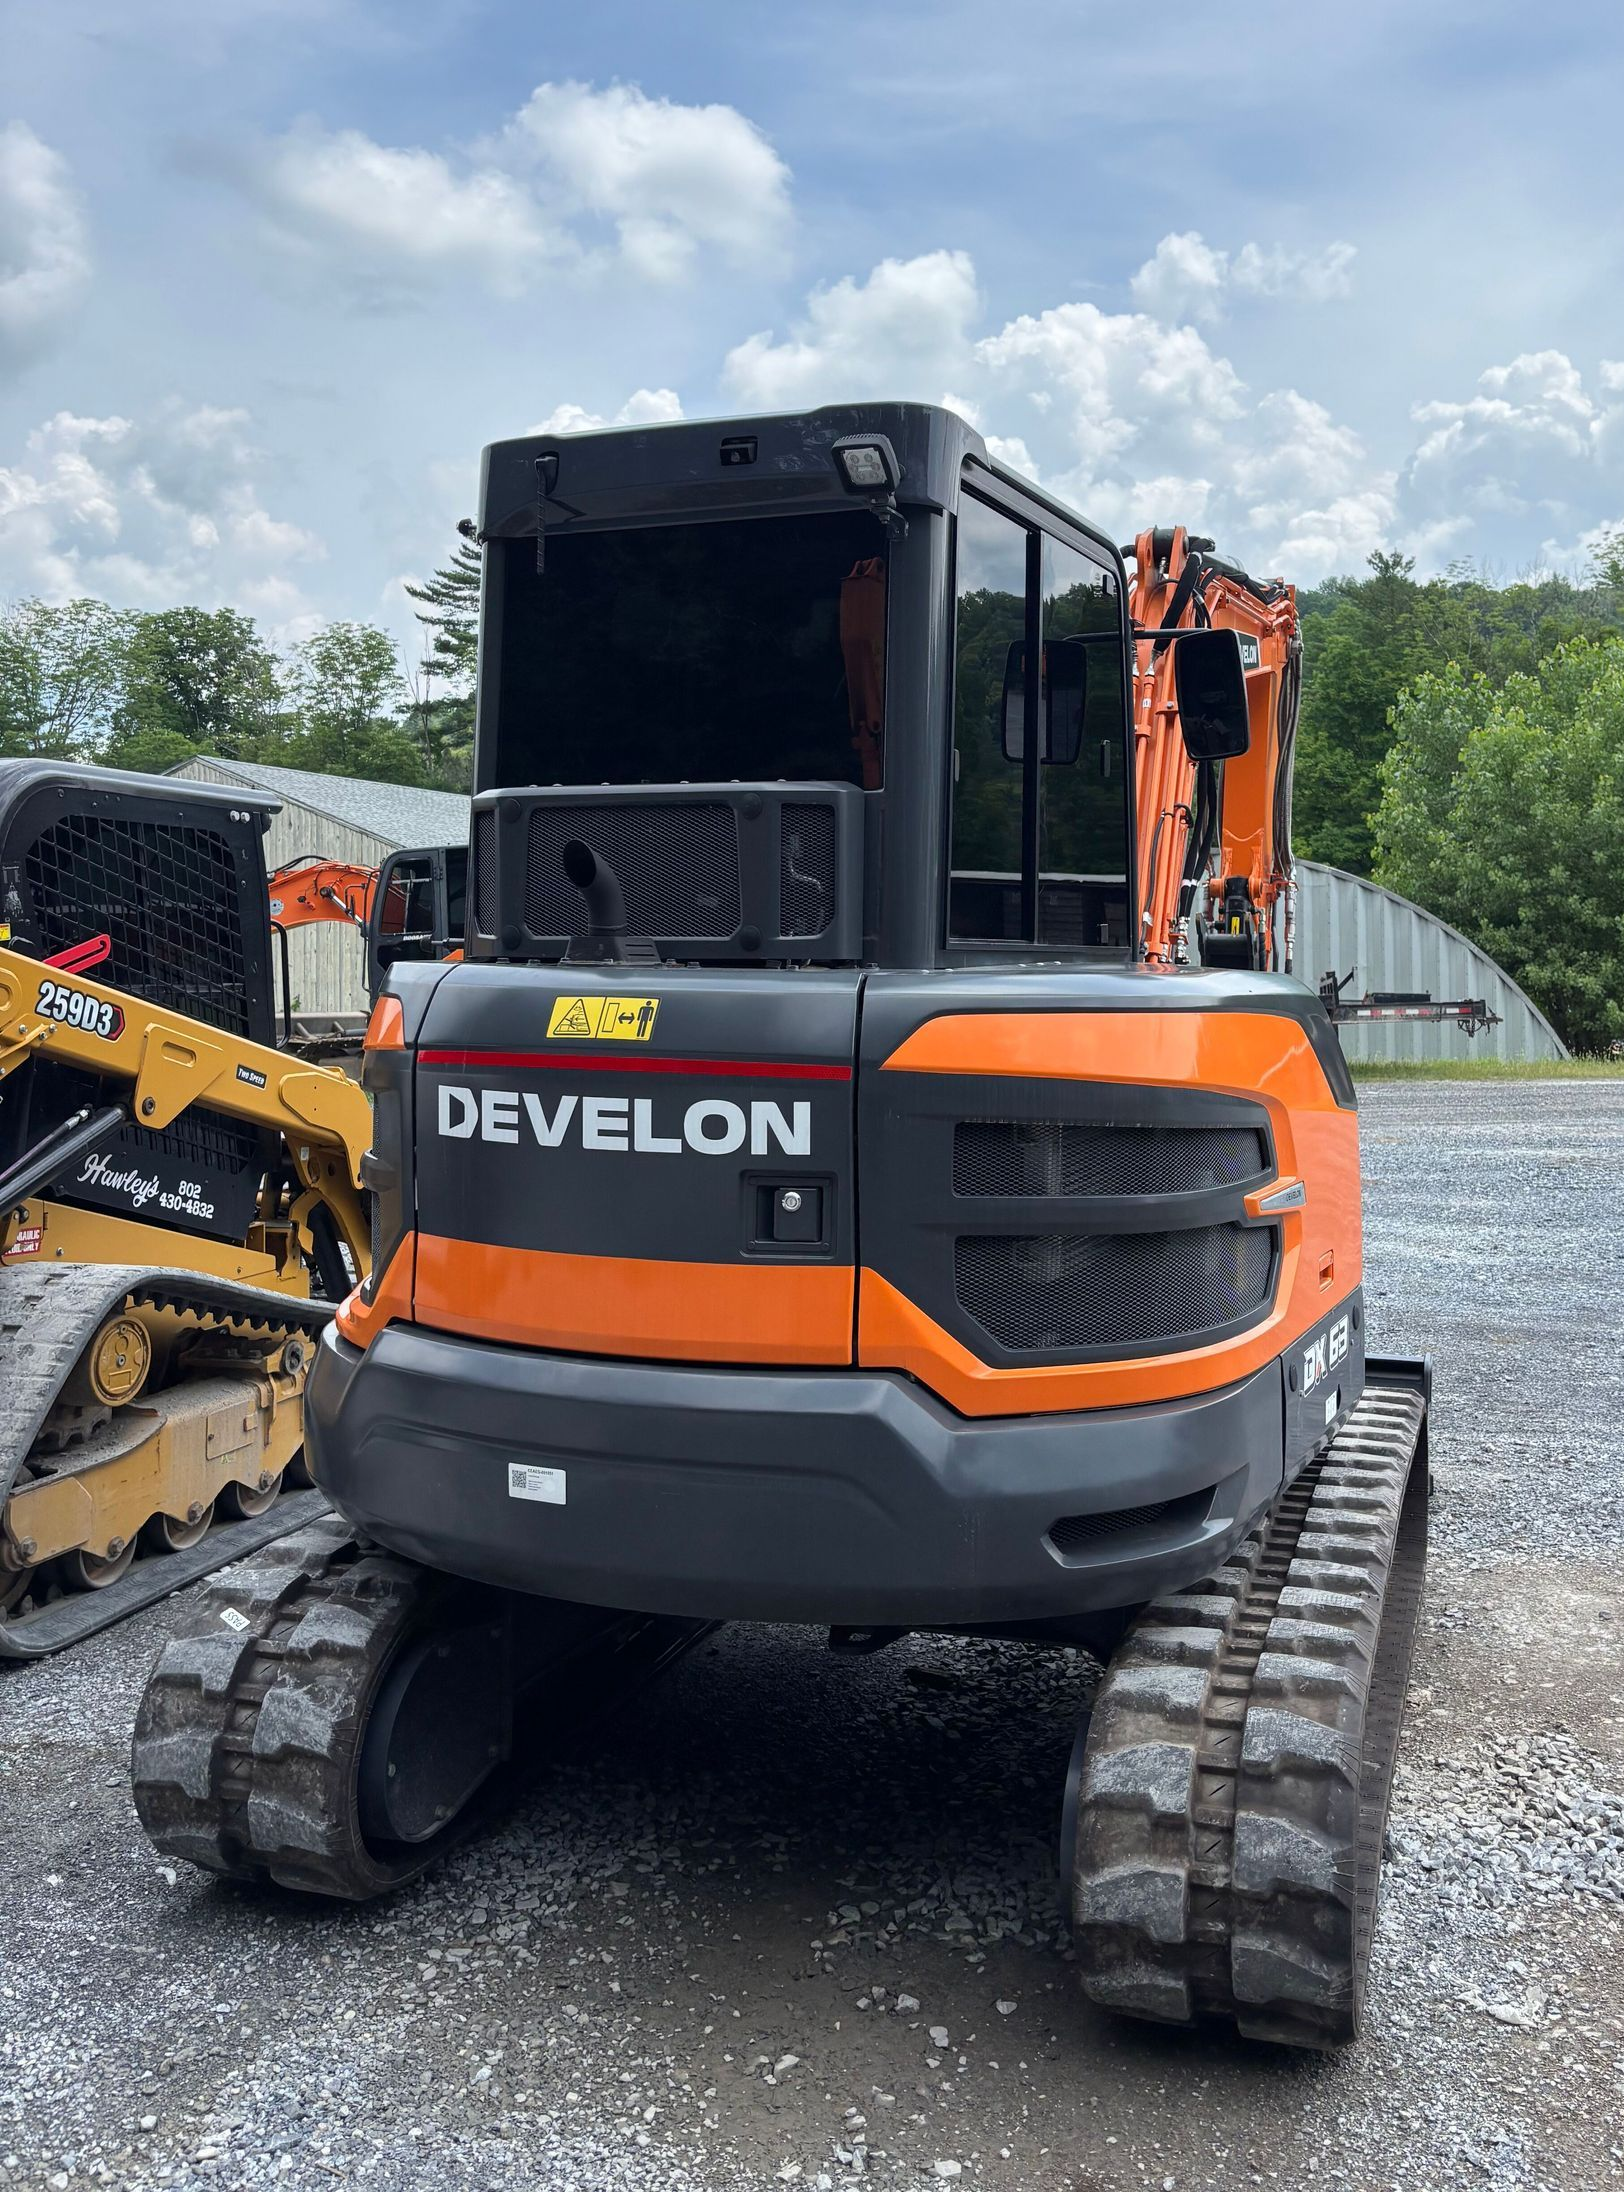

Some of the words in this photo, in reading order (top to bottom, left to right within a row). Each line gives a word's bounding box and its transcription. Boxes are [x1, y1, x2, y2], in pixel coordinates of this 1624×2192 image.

[35, 980, 114, 1037] 259D3
[438, 1084, 811, 1156] DEVELON
[76, 1153, 160, 1208] Hawley's
[159, 1192, 215, 1219] 430-4832
[178, 1180, 202, 1200] 802
[1303, 1333, 1328, 1398] DX
[1329, 1314, 1349, 1371] 63
[224, 1611, 246, 1628] PASS
